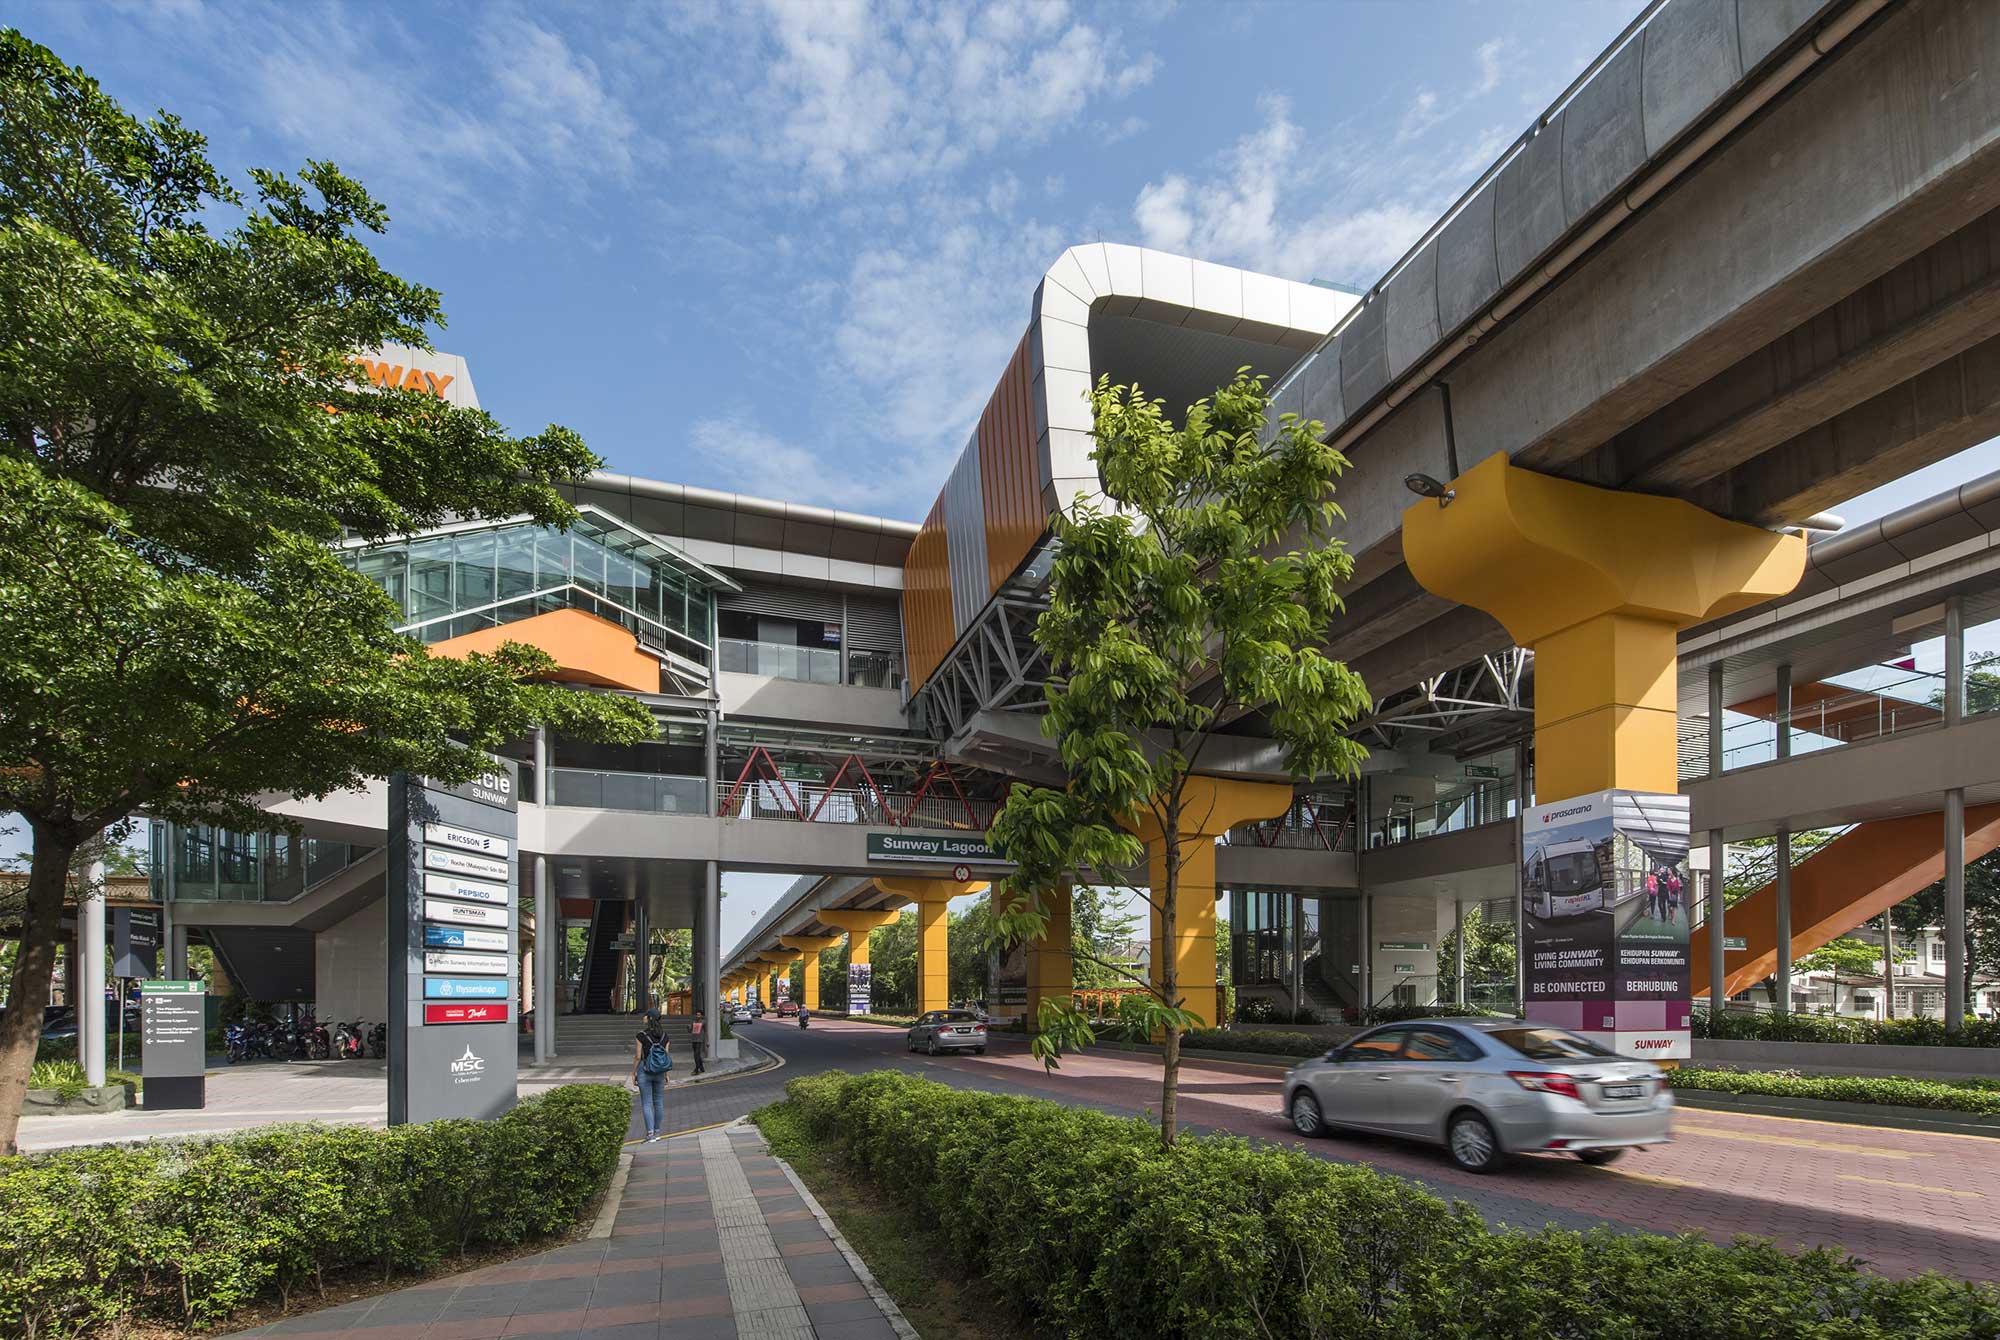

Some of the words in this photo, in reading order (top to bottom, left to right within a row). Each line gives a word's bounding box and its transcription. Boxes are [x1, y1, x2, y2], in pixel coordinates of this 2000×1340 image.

[354, 358, 454, 400] WAY
[472, 788, 508, 805] SUNWAY
[1551, 805, 1592, 821] prasarana
[447, 833, 480, 847] ERICSSON
[883, 837, 939, 853] Sunway
[457, 888, 490, 899] PEPSICO
[452, 908, 486, 916] HUNTSMAN
[1534, 952, 1557, 961] LIVING
[1558, 949, 1599, 960] SUNWAY
[1534, 960, 1557, 969] LIVING
[1558, 958, 1604, 968] COMMUNITY
[1533, 983, 1546, 993] BE
[1547, 981, 1606, 992] CONNECTED
[1626, 981, 1678, 992] BERHUBUNG
[1634, 1040, 1673, 1050] SUNWAY
[451, 1059, 485, 1072] MSC
